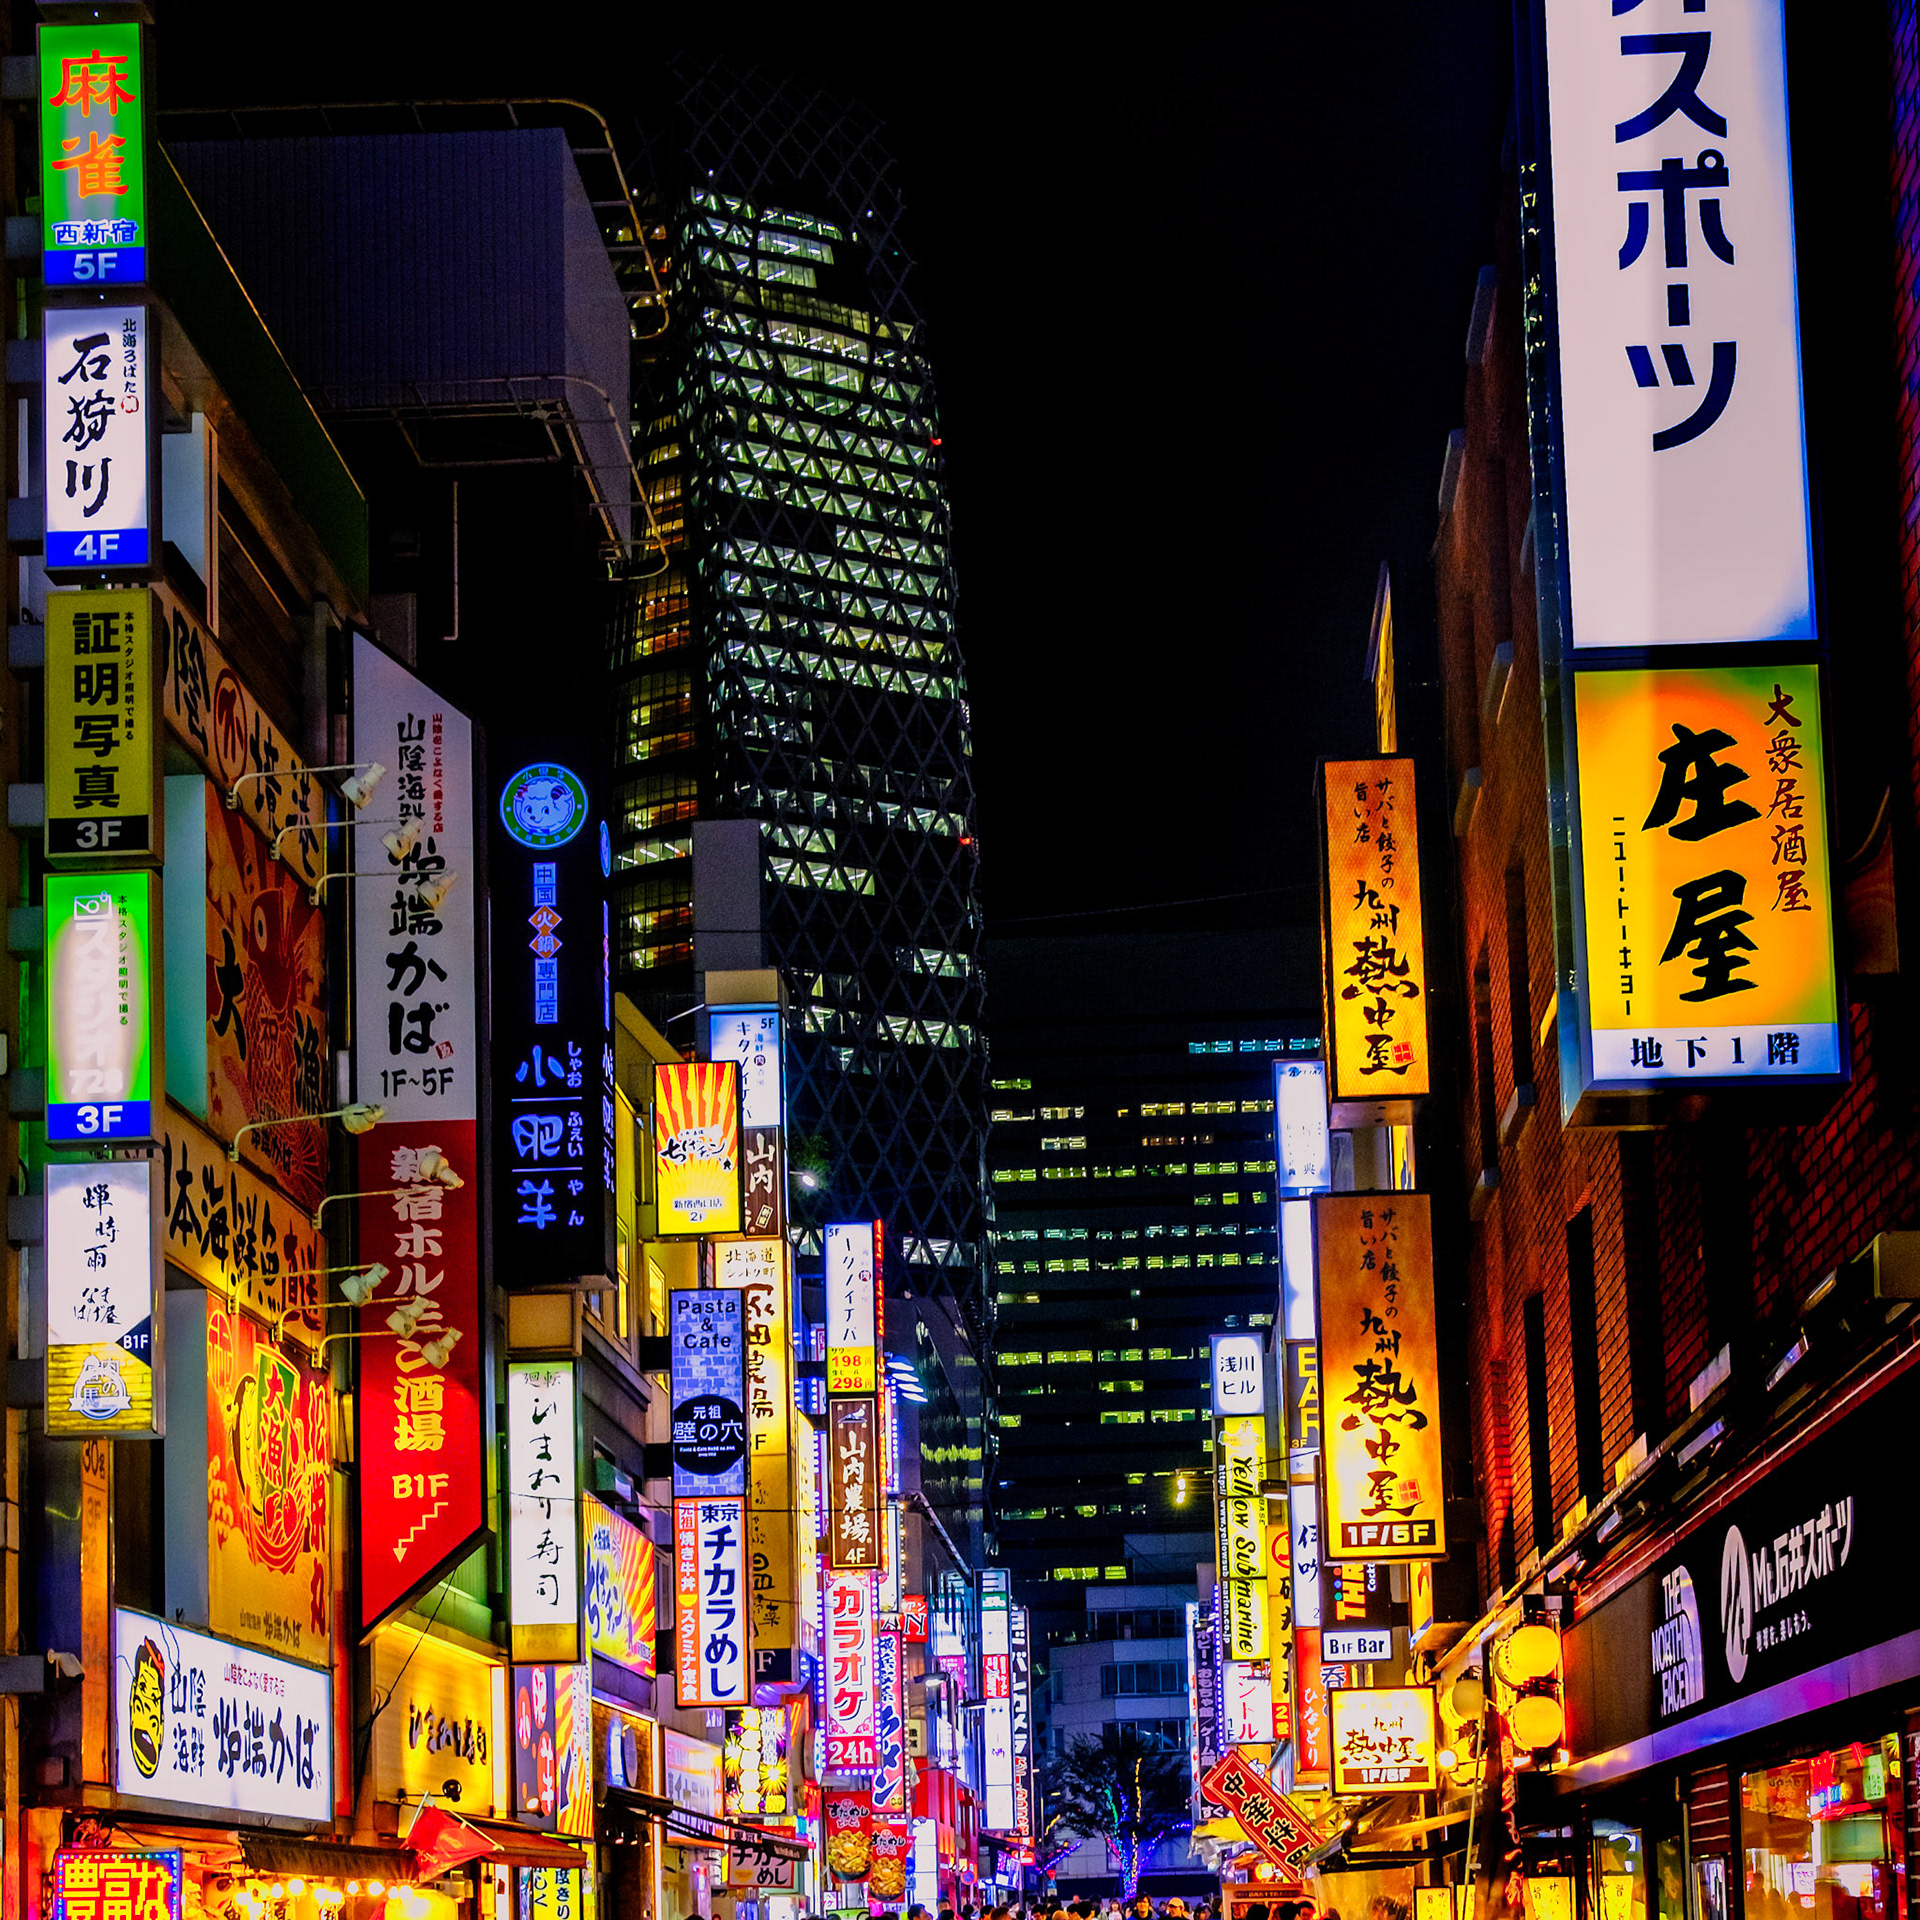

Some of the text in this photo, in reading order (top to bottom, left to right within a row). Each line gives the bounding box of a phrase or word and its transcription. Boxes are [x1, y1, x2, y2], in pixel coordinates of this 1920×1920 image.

[49, 49, 135, 198] 麻雀
[52, 220, 138, 245] 西新宿
[1612, 0, 1737, 452] スポーツ
[73, 254, 117, 280] 5F
[122, 318, 138, 393] 北海ろばた
[58, 332, 116, 518] 石狩川
[74, 536, 120, 560] 4F
[73, 612, 120, 810] 証明写真
[1354, 782, 1370, 843] 旨い店
[1764, 683, 1811, 912] 大衆居酒屋
[76, 821, 122, 848] 3F
[1375, 777, 1396, 889] サバと餃子の
[1641, 723, 1762, 1002] 庄屋
[1353, 880, 1399, 935] 九州
[1613, 816, 1634, 1017] ニュー・トーキョー
[761, 1018, 775, 1029] 5F
[1342, 936, 1419, 1075] 熱中屋
[1630, 1032, 1800, 1068] 地下1階
[77, 1105, 123, 1133] 3F
[512, 1045, 565, 1230] 小肥羊
[567, 1041, 584, 1226] しゃお ふぇい やん
[747, 1133, 775, 1194] 山内
[726, 1247, 775, 1263] 北海道
[828, 1228, 839, 1238] 5F
[1360, 1210, 1376, 1271] 旨い店
[1380, 1208, 1401, 1318] サバと餃子の
[677, 1299, 736, 1314] Pasta
[701, 1318, 713, 1331] &
[1361, 1307, 1401, 1358] 九州
[123, 1334, 149, 1349] B1F
[684, 1333, 731, 1348] Cafe
[1220, 1356, 1255, 1372] 浅川
[673, 1419, 743, 1443] 壁の穴
[693, 1405, 721, 1419] 元祖
[1340, 1359, 1428, 1517] 熱中屋
[1291, 1439, 1307, 1448] 3F
[392, 1473, 449, 1498] B1F
[527, 1398, 563, 1606] ひまわり寿司
[839, 1430, 869, 1543] 山内農場
[701, 1504, 738, 1523] 東京
[845, 1548, 866, 1563] 4F
[1232, 1456, 1260, 1653] Yellow Submarine
[679, 1503, 698, 1700] 元祖 焼き牛丼 スタミナ定食
[704, 1525, 738, 1697] チカラめし
[1662, 1569, 1681, 1620] THE
[833, 1585, 866, 1720] カラオケ
[1329, 1637, 1384, 1654] B1F Bar
[1651, 1613, 1684, 1675] NORTH
[171, 1667, 206, 1719] 山陰
[1662, 1661, 1686, 1718] FACE
[173, 1723, 205, 1777] 海鮮
[213, 1697, 320, 1789] 炉端かば
[828, 1740, 874, 1765] 24h
[1304, 1687, 1318, 1767] ひなどり
[827, 1801, 869, 1817] すためし
[871, 1831, 905, 1846] すためし
[757, 1868, 788, 1885] めし
